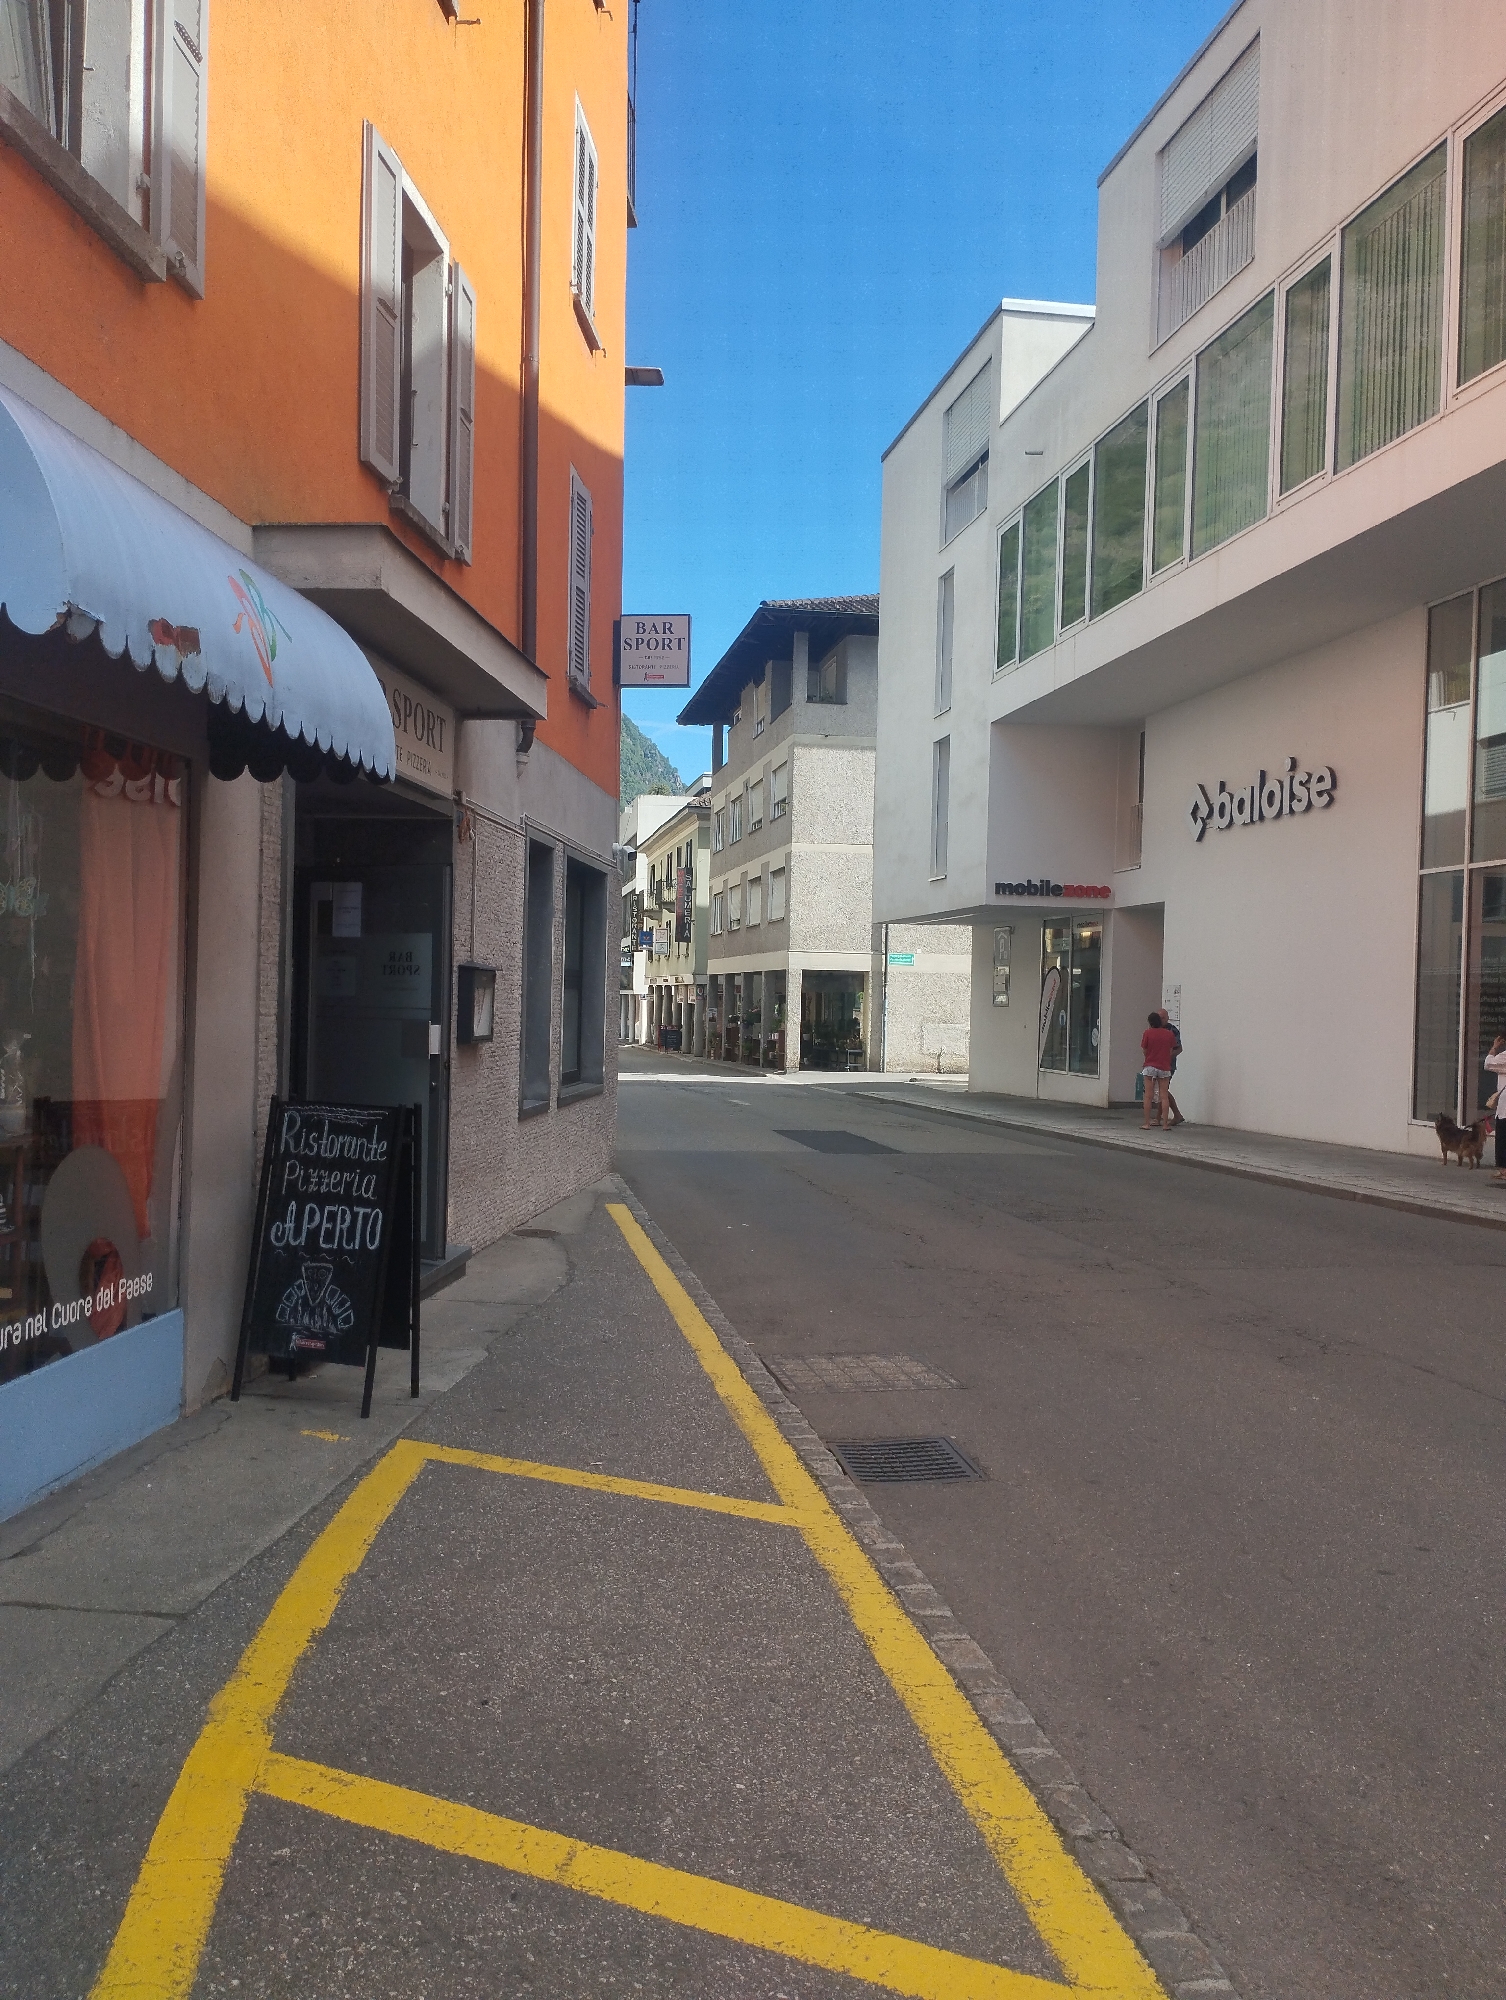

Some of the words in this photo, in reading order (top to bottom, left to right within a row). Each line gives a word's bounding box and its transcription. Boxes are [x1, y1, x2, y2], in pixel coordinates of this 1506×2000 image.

[623, 637, 686, 651] SPORT
[635, 621, 674, 634] BAR
[393, 688, 446, 753] SPORT
[1213, 755, 1338, 831] baloise
[683, 874, 692, 938] SALUMERIA
[994, 879, 1112, 899] mobilezone
[280, 1111, 388, 1162] Ristorante
[282, 1160, 378, 1200] Pizzeria
[270, 1200, 383, 1250] APERTO
[25, 1307, 48, 1341] nel
[51, 1295, 93, 1329] Cuore
[96, 1282, 115, 1312] del
[118, 1272, 153, 1303] Paese
